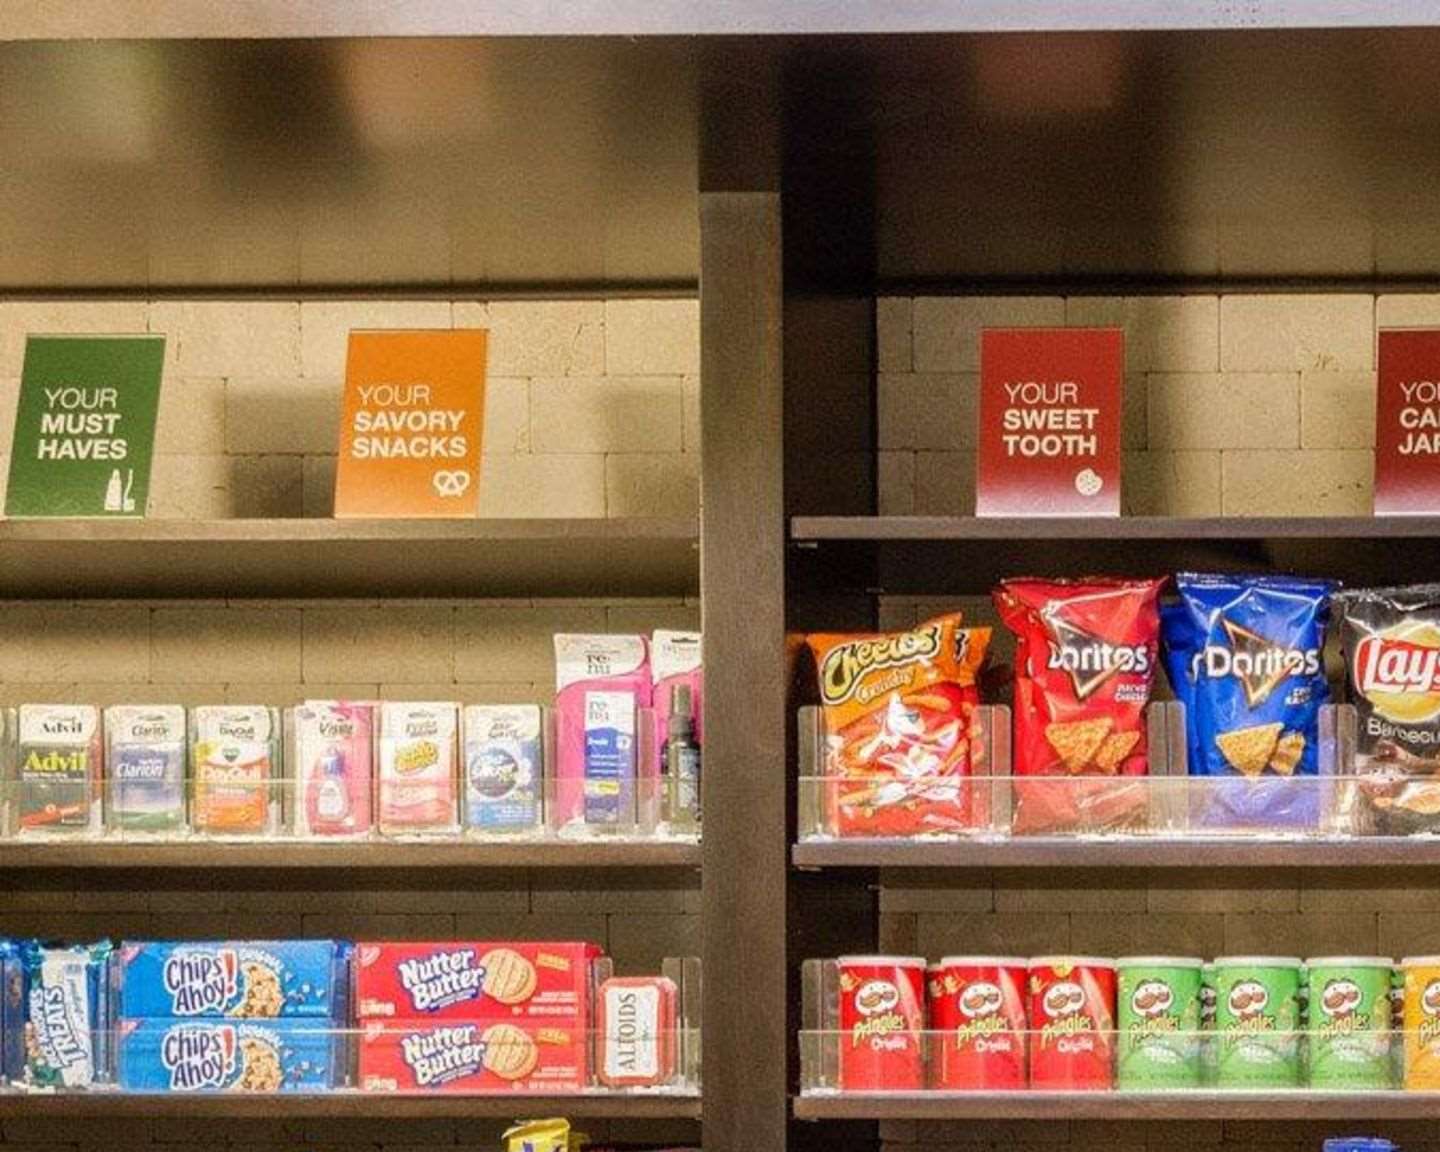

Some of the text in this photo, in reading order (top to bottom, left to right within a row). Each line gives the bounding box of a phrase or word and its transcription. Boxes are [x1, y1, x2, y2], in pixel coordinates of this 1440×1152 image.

[45, 387, 117, 409] YOUR
[357, 384, 431, 407] YOUR
[1003, 382, 1079, 405] YOUR
[41, 413, 121, 435] MUST
[353, 410, 466, 433] SAVORY
[1003, 408, 1099, 431] SWEET
[37, 438, 128, 460] HAVES
[352, 436, 468, 459] SNACKS
[1002, 434, 1097, 457] TOOTH
[1048, 641, 1149, 671] Doritos
[1207, 648, 1319, 678] Doritos
[23, 751, 87, 772] Advil
[165, 954, 224, 989] Chips
[399, 949, 475, 987] Nutter
[411, 966, 485, 1010] Butter
[44, 985, 88, 1067] TREATS
[618, 993, 636, 1070] ALTOIDS
[853, 1012, 905, 1048] Pringles
[958, 1012, 1009, 1050] Pringles
[1041, 1013, 1092, 1050] Pringles
[163, 1031, 222, 1066] Chips
[401, 1025, 477, 1064] Nutter
[414, 1041, 486, 1085] Butter
